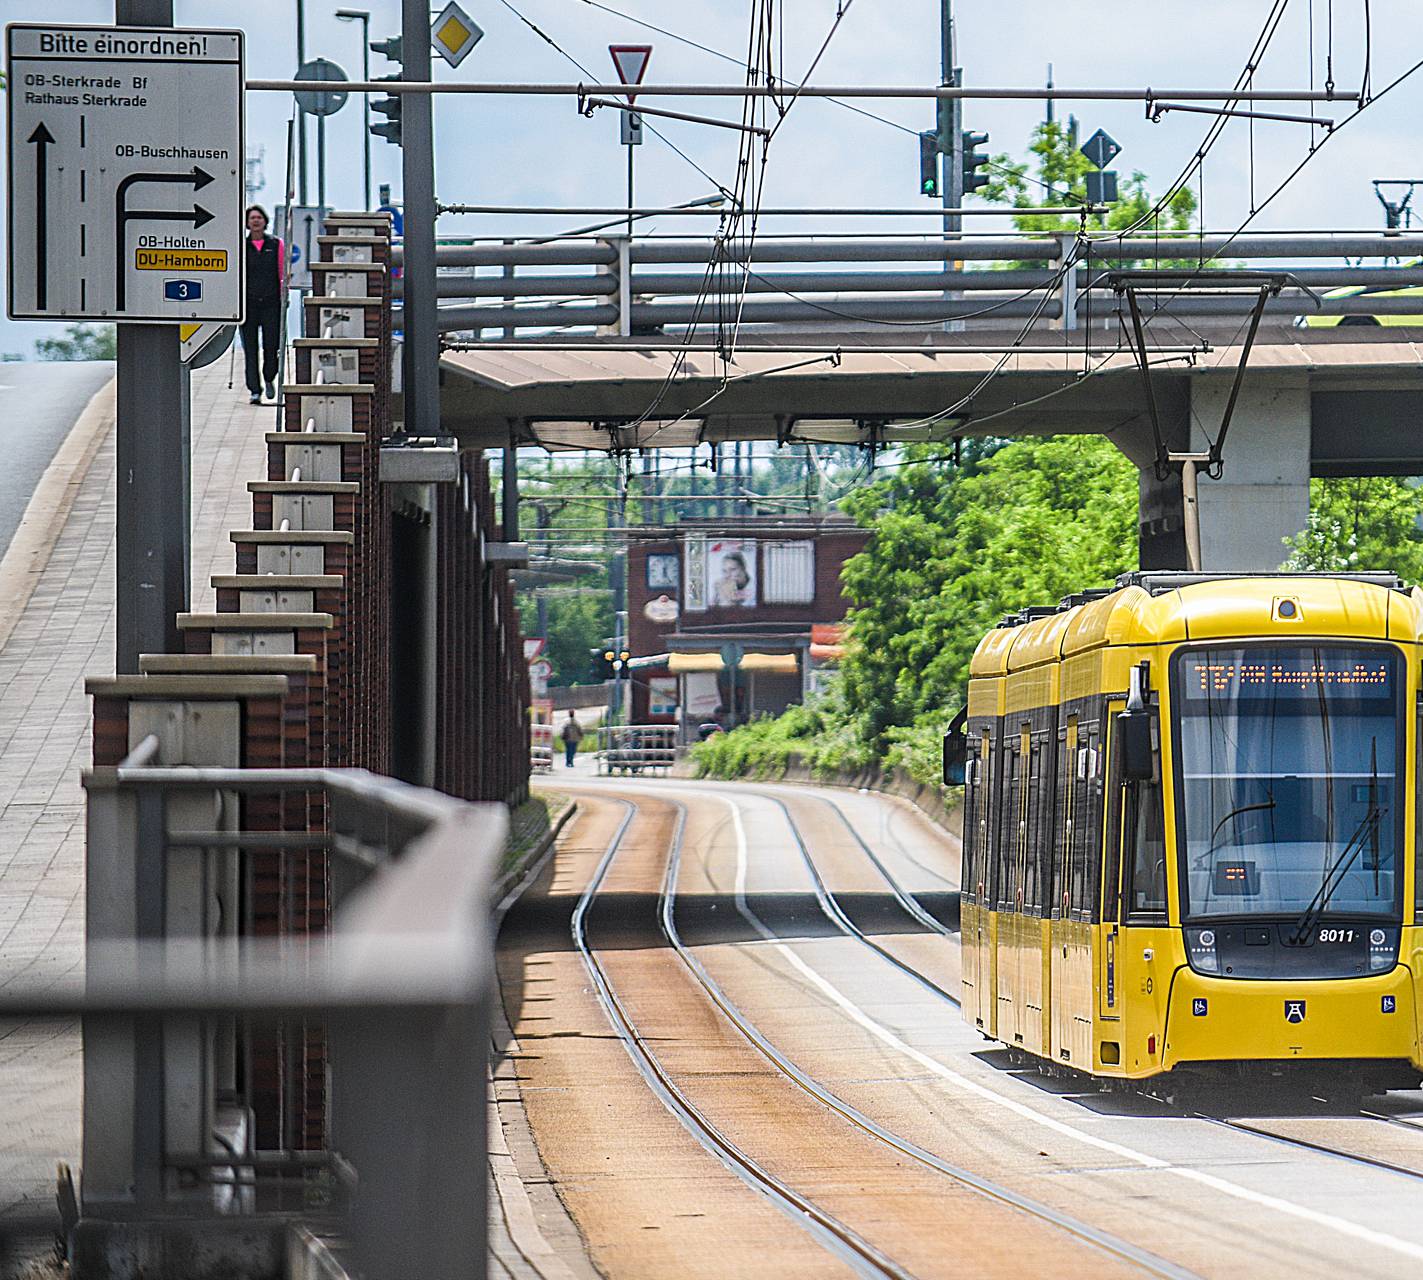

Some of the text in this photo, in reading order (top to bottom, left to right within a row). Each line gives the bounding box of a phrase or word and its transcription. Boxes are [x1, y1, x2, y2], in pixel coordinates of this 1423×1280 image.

[39, 33, 208, 56] Bitte einordnen!
[24, 74, 147, 89] OB-Sterkrade Bf
[25, 92, 147, 107] Rathaus Sterkrade
[115, 145, 229, 160] OB-Buschhausen
[138, 235, 205, 249] OB-Holten
[138, 253, 224, 268] DU-Hamborn
[178, 284, 188, 297] 3
[1319, 929, 1354, 943] 8011
